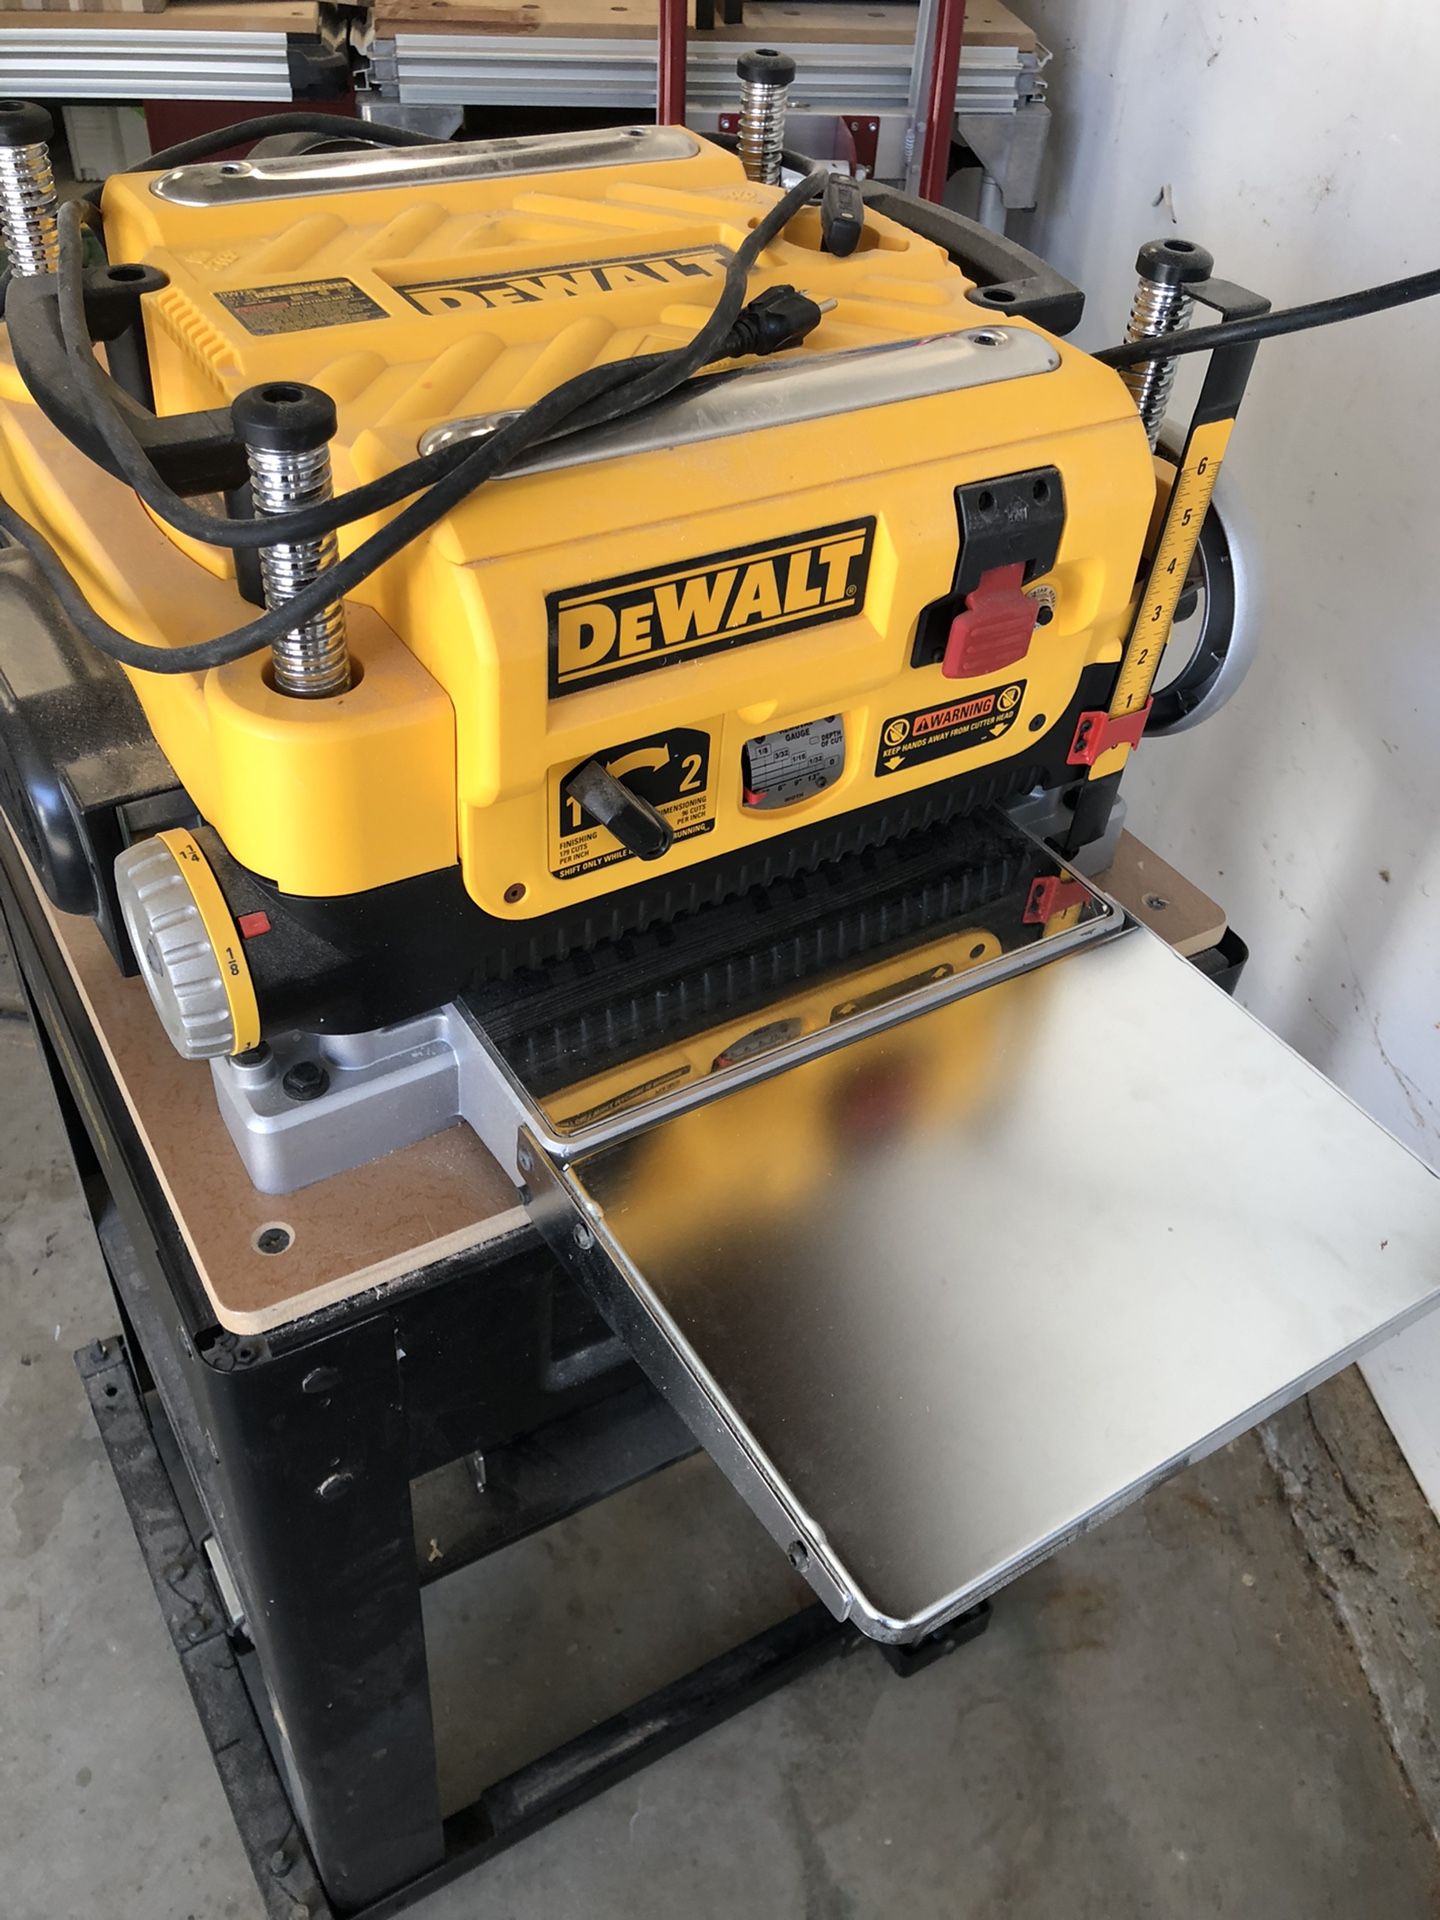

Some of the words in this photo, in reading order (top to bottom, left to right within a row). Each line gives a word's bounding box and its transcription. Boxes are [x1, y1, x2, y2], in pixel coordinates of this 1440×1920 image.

[1196, 457, 1209, 476] 6
[1181, 508, 1193, 527] 5
[1167, 558, 1177, 575] 4
[1150, 605, 1162, 622] 3
[1137, 649, 1149, 665] 2
[1126, 693, 1134, 709] 1
[930, 698, 992, 728] WARNING
[785, 728, 810, 742] GAUGE
[883, 746, 901, 757] KEEP
[902, 737, 927, 752] HANDS
[927, 731, 950, 745] AWAY
[950, 724, 970, 737] FROM
[970, 716, 995, 730] CUTTER
[995, 710, 1014, 722] HEAD
[679, 754, 702, 792] 2
[566, 796, 582, 828] 1
[690, 803, 706, 814] CUTS
[559, 831, 598, 850] FINISHING
[571, 843, 588, 854] CUTS
[559, 856, 572, 865] PER
[573, 850, 590, 859] INCH
[559, 864, 582, 878] SHIFT
[582, 857, 603, 870] ONLY
[603, 848, 628, 863] WHILE
